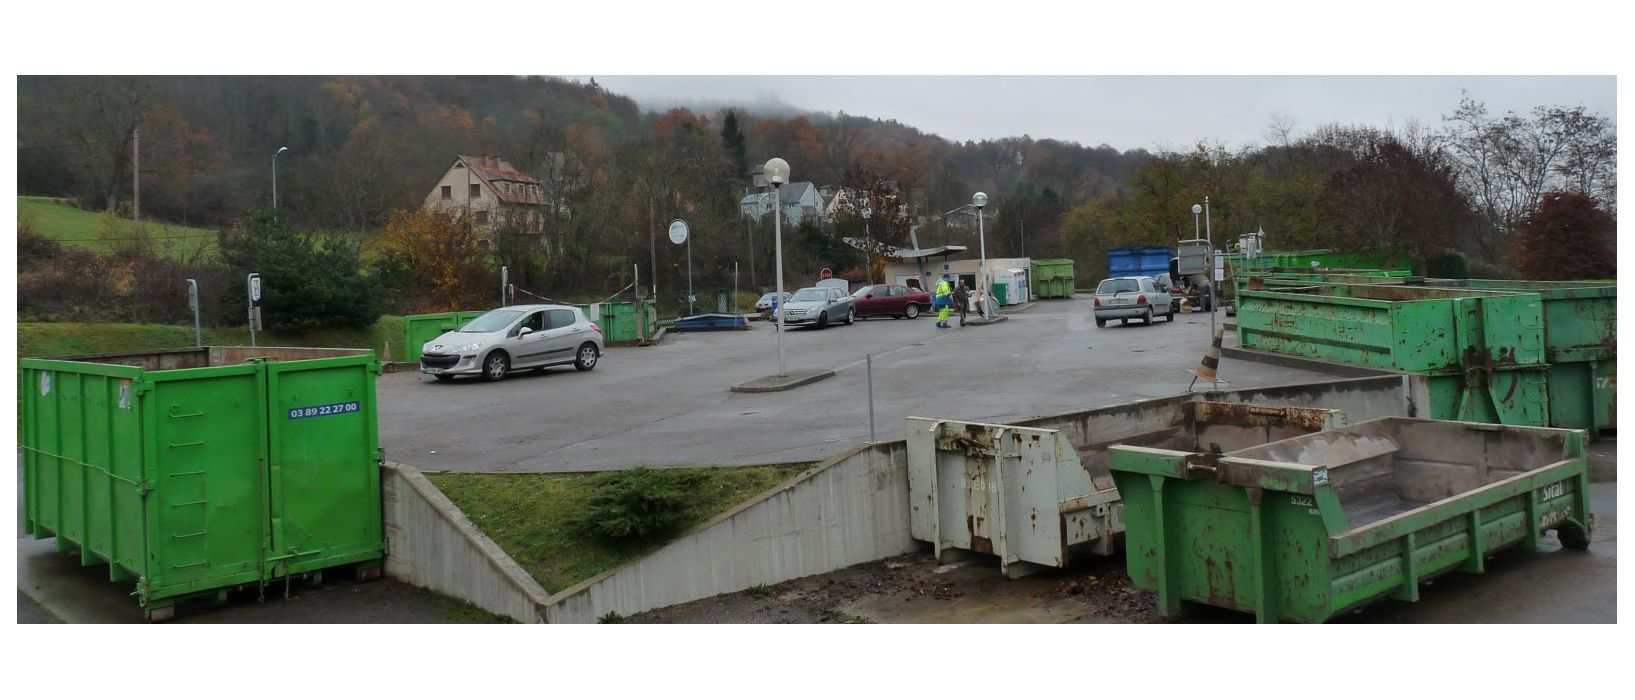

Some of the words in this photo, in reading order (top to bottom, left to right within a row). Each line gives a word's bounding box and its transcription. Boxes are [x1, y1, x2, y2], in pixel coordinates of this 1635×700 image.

[291, 409, 304, 418] 03
[305, 408, 318, 417] 89
[320, 406, 331, 415] 22
[333, 404, 344, 413] 27
[346, 403, 357, 412] 00
